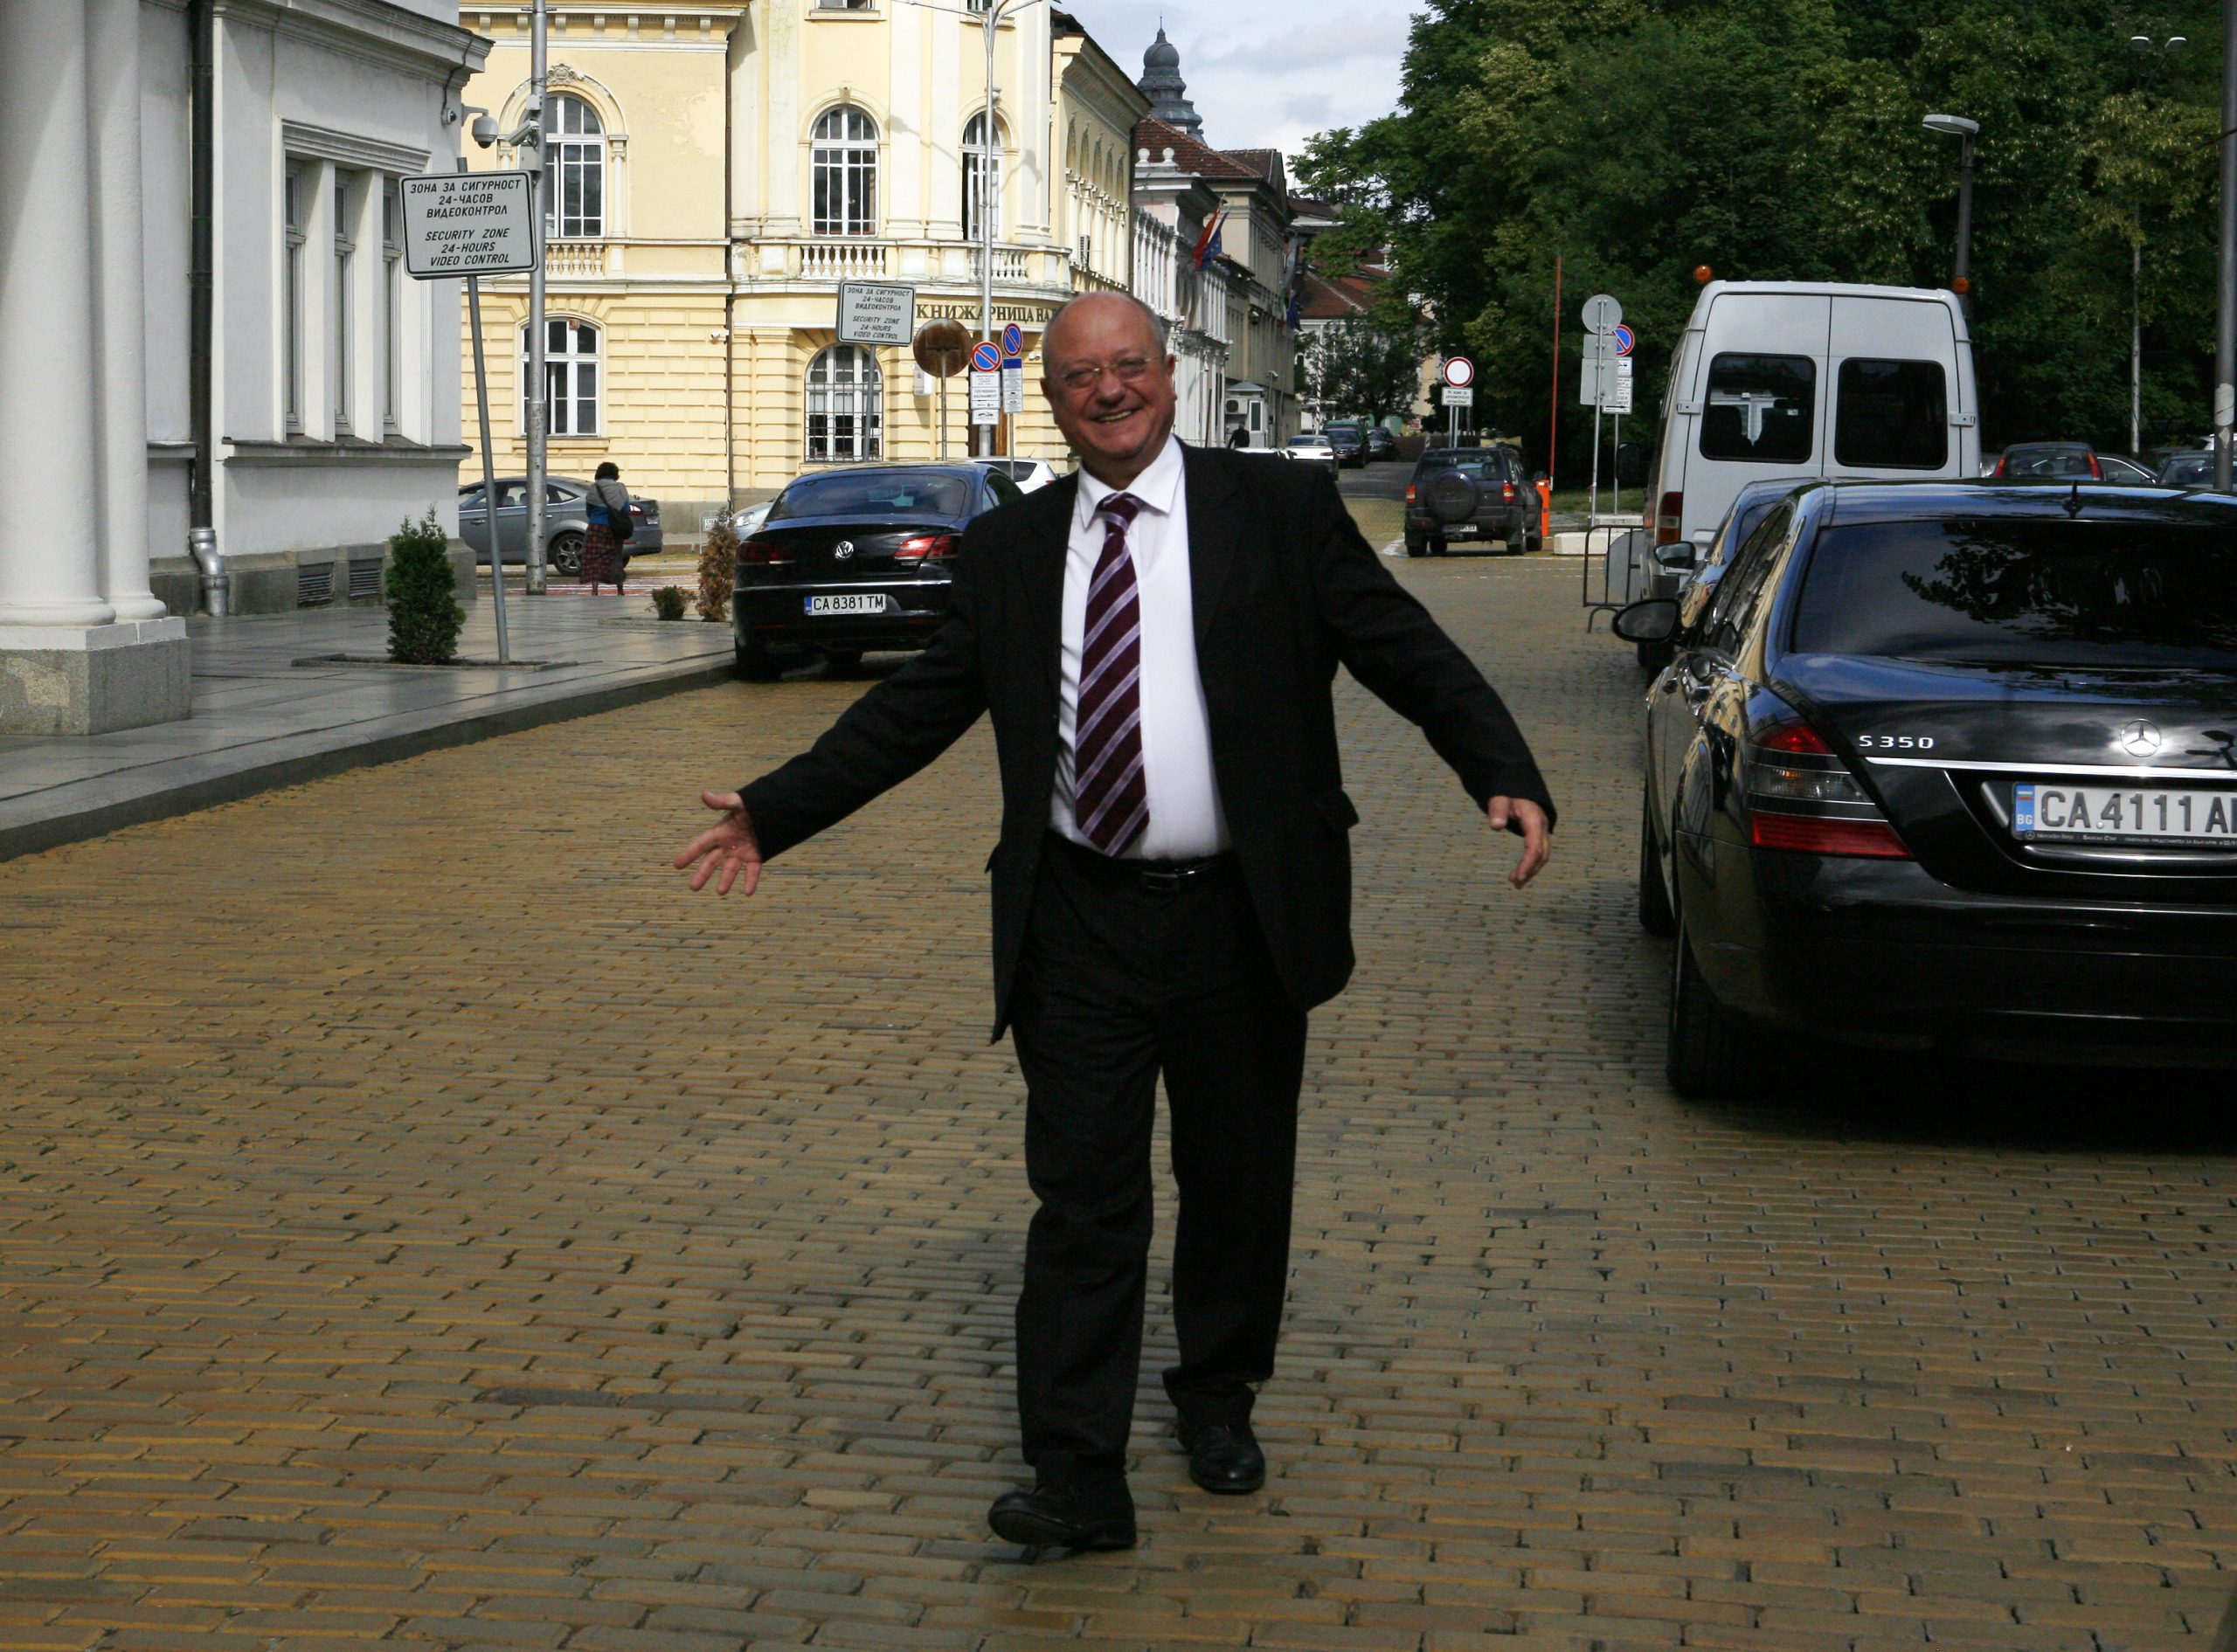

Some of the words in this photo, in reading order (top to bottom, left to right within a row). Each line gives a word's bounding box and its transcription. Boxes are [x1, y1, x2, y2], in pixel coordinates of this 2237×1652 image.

[410, 183, 437, 194] ЗОНА
[443, 183, 455, 192] ЗА
[461, 179, 521, 192] СИГУРНОСТ
[439, 193, 494, 205] 24-ЧАСОВ
[426, 205, 508, 218] ВИДЕОКОНТРОЛ
[425, 230, 474, 241] SECURITY
[482, 228, 510, 238] ZONE
[441, 242, 495, 253] 24-HOURS
[430, 255, 460, 266] VIDEO
[464, 253, 509, 265] CONTROL
[855, 302, 901, 311] ВИДЕОКОНТРОЛ
[2017, 814, 2033, 825] BG
